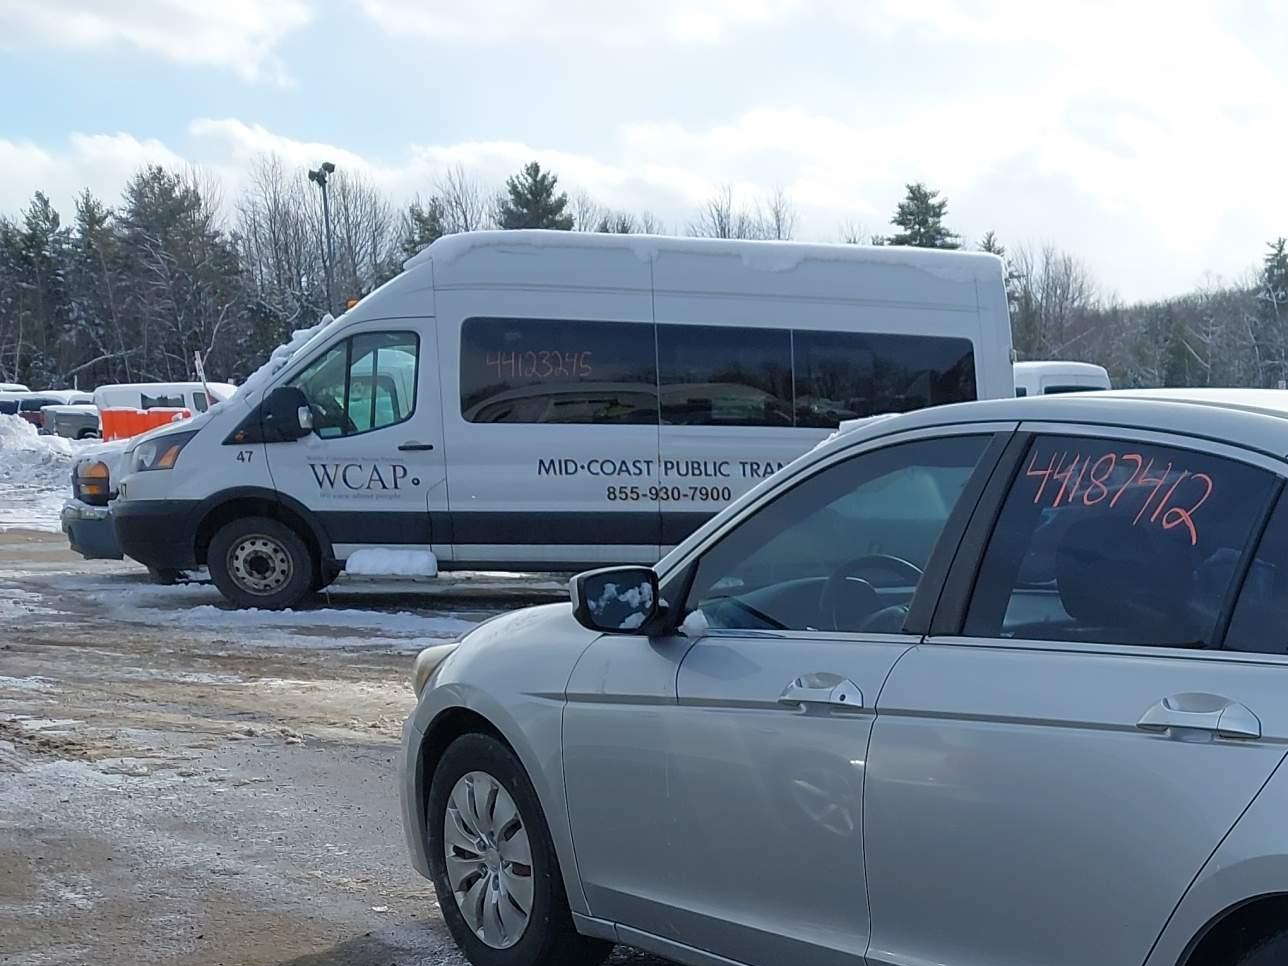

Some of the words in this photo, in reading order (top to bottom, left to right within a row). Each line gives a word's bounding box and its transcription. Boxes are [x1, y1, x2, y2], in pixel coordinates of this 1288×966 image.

[236, 450, 254, 463] 47
[663, 460, 731, 478] PUBLIC
[606, 486, 732, 502] 855-930-7900
[1026, 450, 1213, 546] 44187412
